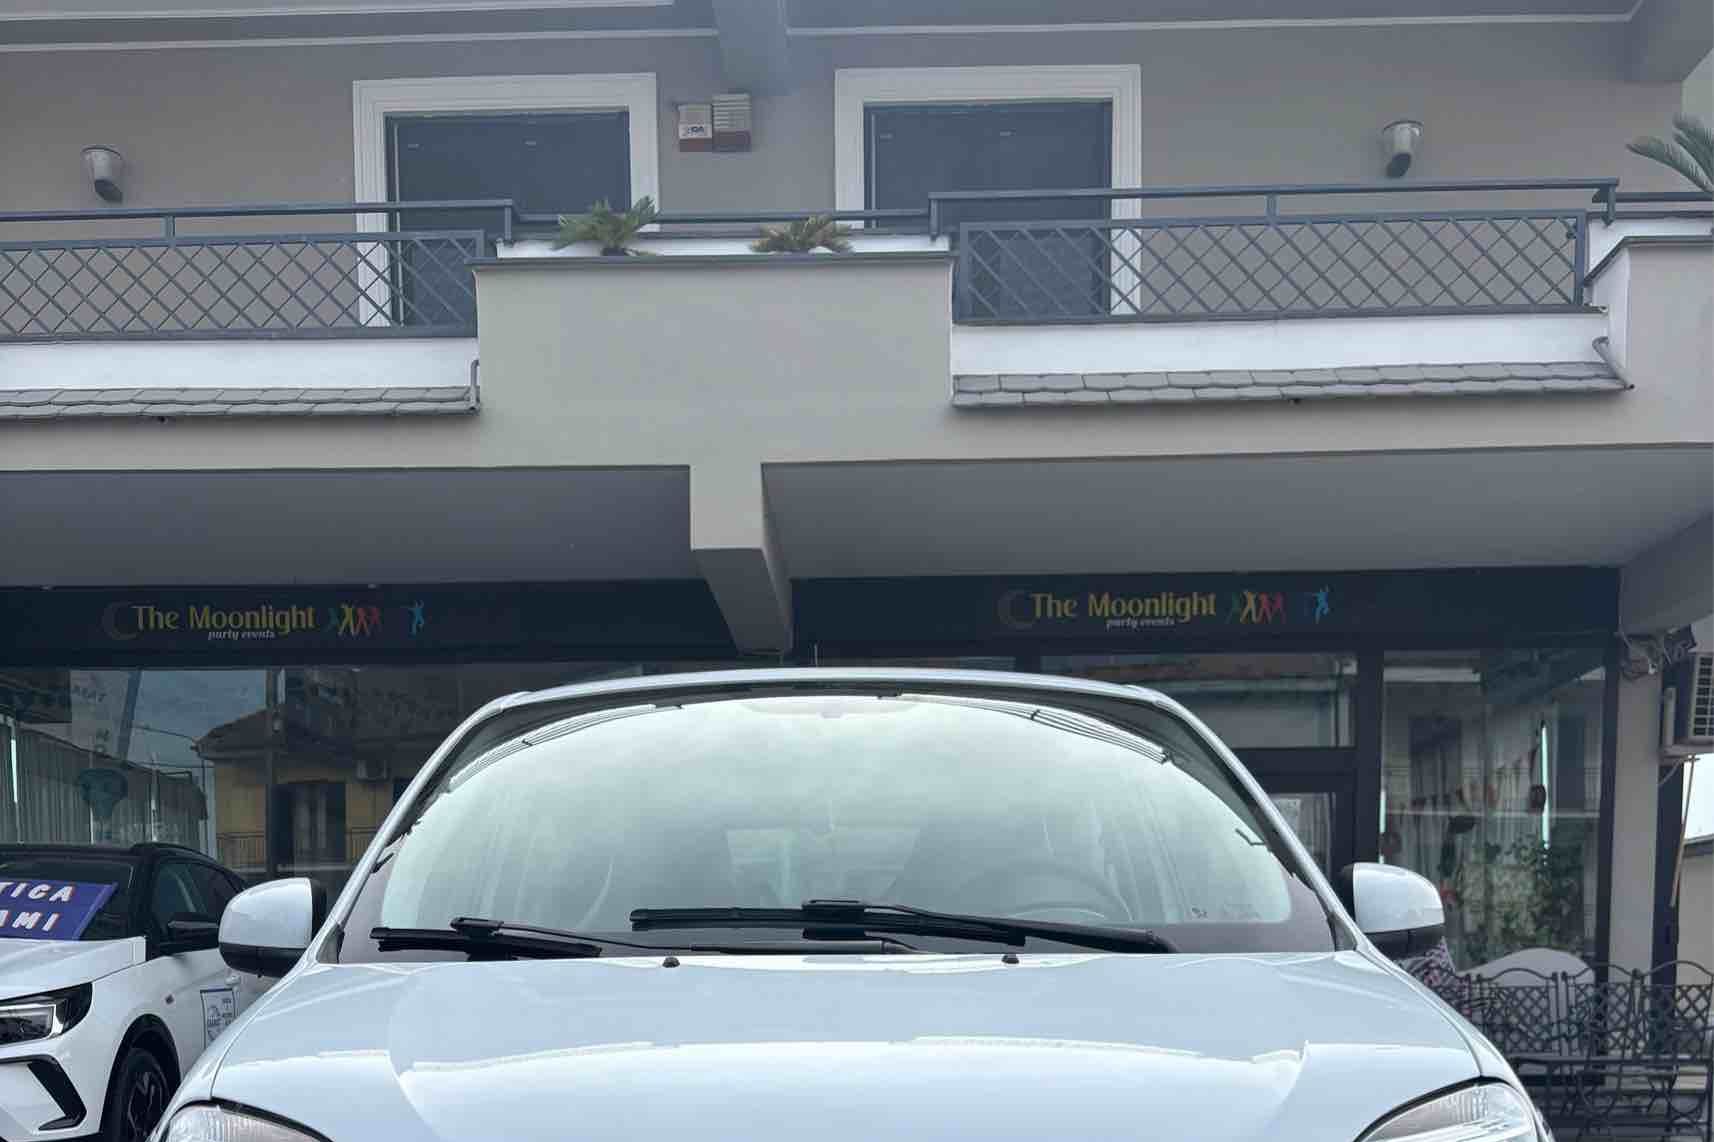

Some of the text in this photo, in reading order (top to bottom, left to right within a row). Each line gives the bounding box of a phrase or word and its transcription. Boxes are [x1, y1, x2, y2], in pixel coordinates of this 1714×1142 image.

[1030, 591, 1216, 622] The Moonlight
[131, 604, 315, 634] The Moonlight
[1106, 616, 1175, 630] party events
[207, 629, 276, 641] party events
